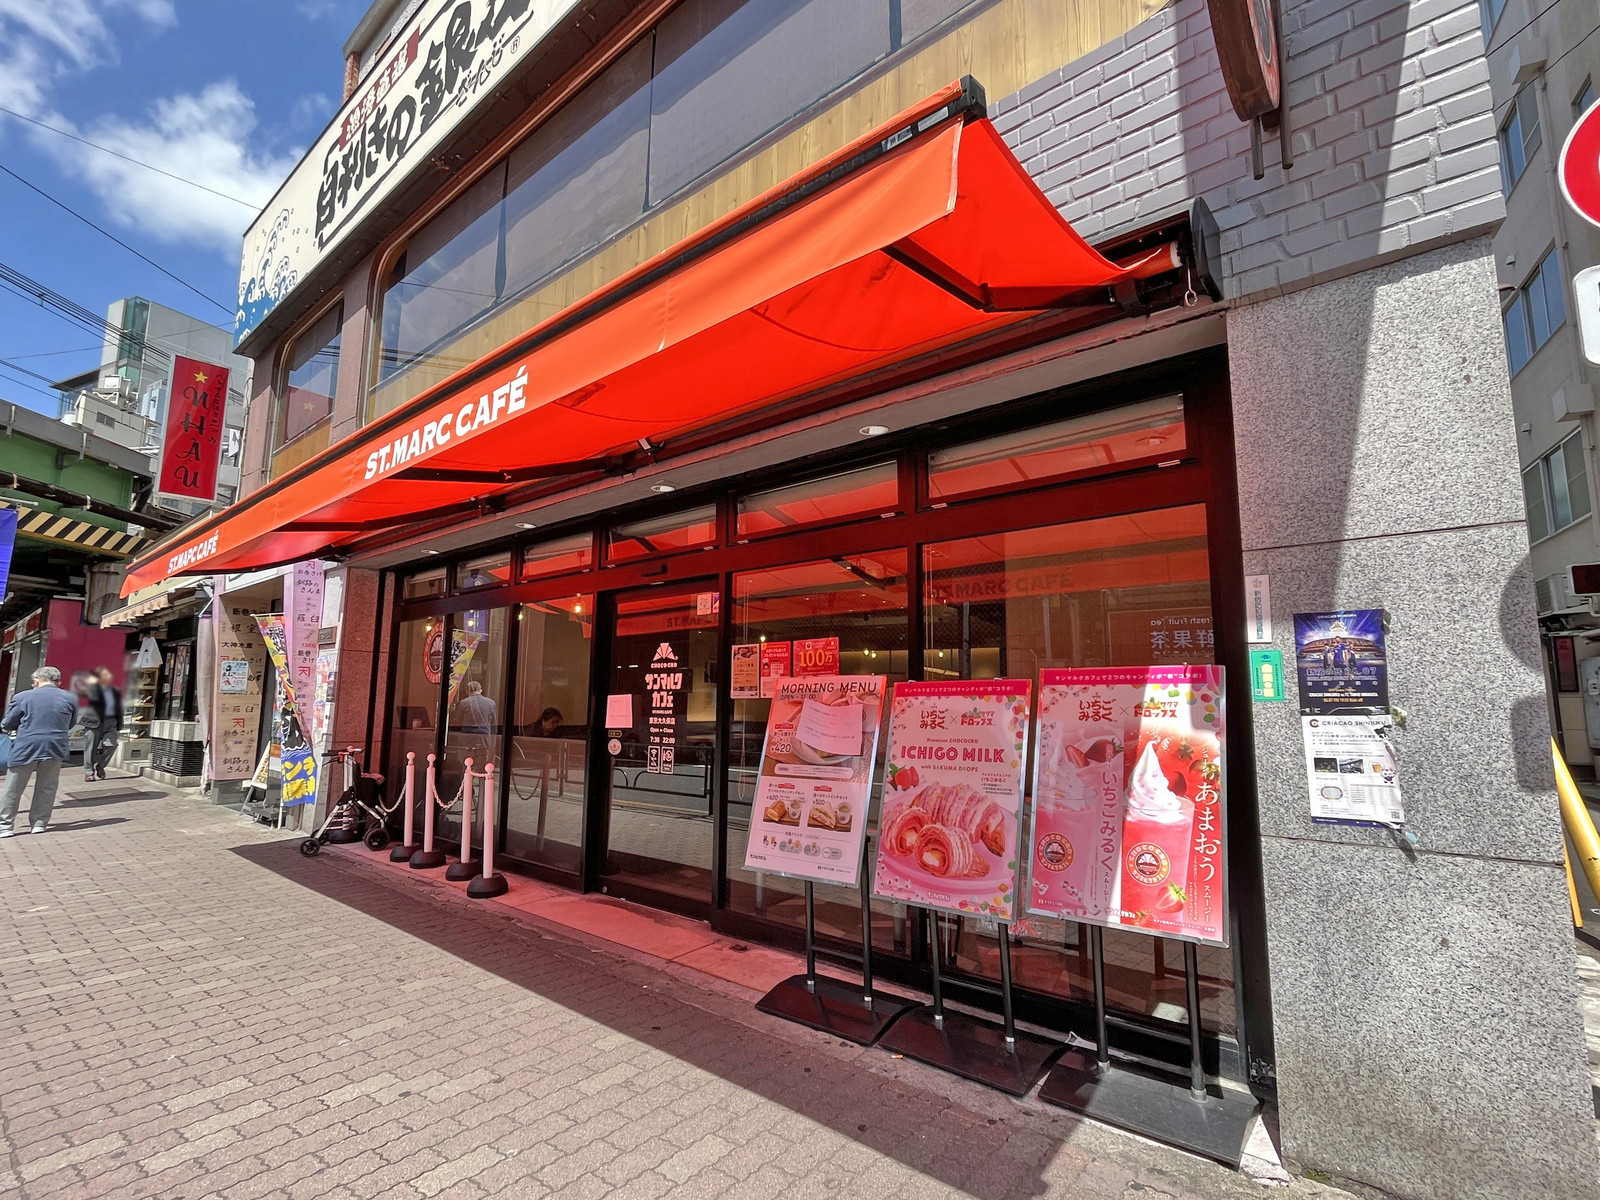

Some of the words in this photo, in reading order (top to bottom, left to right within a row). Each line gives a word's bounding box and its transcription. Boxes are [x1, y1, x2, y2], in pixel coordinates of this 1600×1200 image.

[364, 413, 453, 480] ST.MARC
[455, 364, 528, 437] CAFÉ
[645, 672, 683, 690] サンマルク
[781, 682, 835, 694] MORNING
[840, 681, 877, 693] MENU
[652, 691, 674, 708] カフェ
[1079, 698, 1117, 711] いちご
[920, 708, 949, 720] いちご
[1078, 711, 1113, 722] みるく
[1134, 709, 1178, 718] ドロップス
[919, 719, 946, 730] みるく
[960, 718, 993, 726] ドロップス
[901, 745, 958, 760] ICHIGO
[962, 748, 1005, 763] MILK
[1100, 771, 1117, 872] いちごみるく
[1195, 782, 1221, 881] あまおう
[1203, 885, 1212, 923] スムージー
